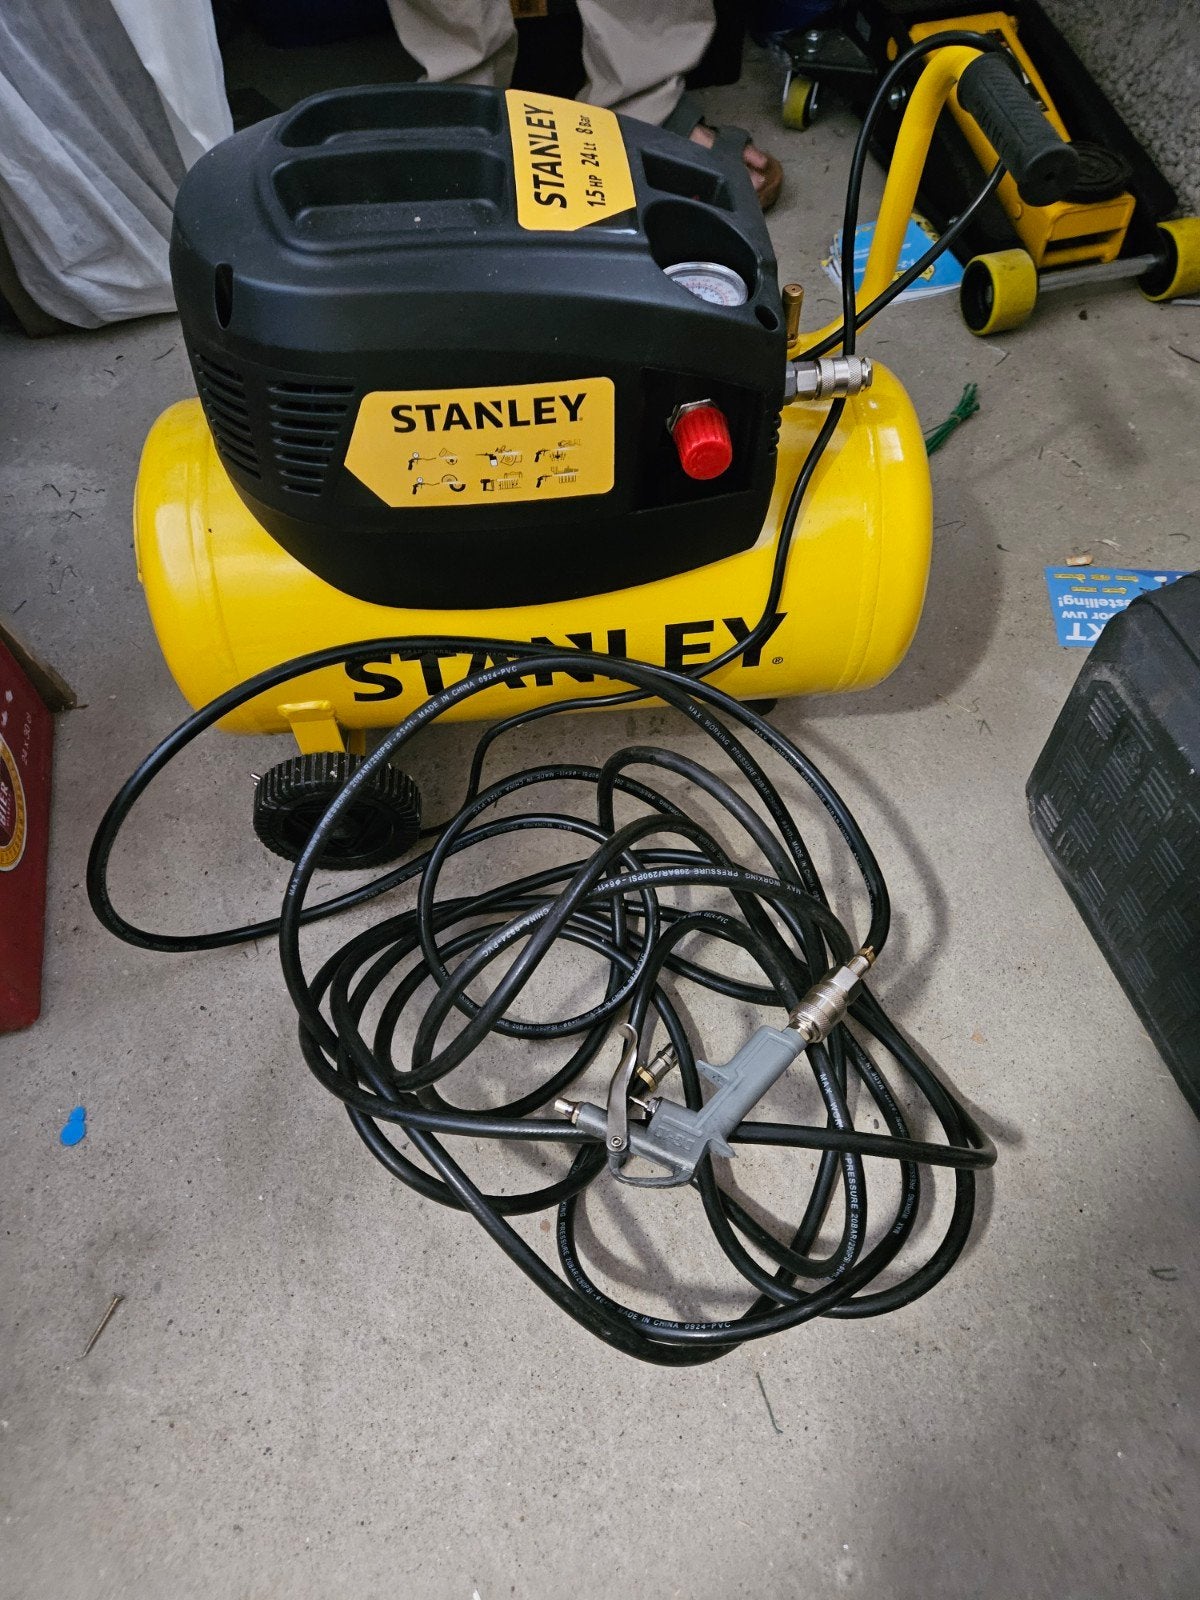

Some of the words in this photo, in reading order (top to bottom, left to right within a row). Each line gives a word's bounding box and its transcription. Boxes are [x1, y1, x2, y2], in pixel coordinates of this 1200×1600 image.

[575, 127, 594, 135] 8
[523, 103, 567, 209] STANLEY
[580, 152, 600, 167] 24
[390, 393, 587, 434] STANLEY
[1061, 610, 1088, 619] uw
[343, 611, 788, 702] STANLEY
[771, 742, 798, 770] WORKING
[287, 878, 300, 897] MAX
[297, 833, 322, 872] WORKING
[319, 788, 352, 830] PRESSURE
[350, 741, 394, 788] 20BAR/290PSI
[416, 700, 440, 720] MADE
[440, 693, 450, 704] IN
[451, 680, 476, 696] CHINA
[478, 665, 519, 684] 0924-PVC
[504, 779, 524, 791] CHINA
[533, 771, 555, 780] MADE
[688, 705, 703, 719] MAX
[704, 719, 731, 746] WORKING
[731, 745, 757, 779] PRESSURE
[791, 840, 804, 859] MADE
[628, 868, 690, 883] 20BAR/290PSI
[693, 867, 740, 878] PRESSURE
[744, 872, 781, 888] WORKING
[786, 883, 802, 896] MAX
[522, 906, 550, 927] CHINA
[819, 1072, 833, 1095] MAX
[844, 1156, 860, 1210] PRESSURE
[892, 1221, 903, 1235] MAX
[901, 1193, 916, 1219] WORKING
[559, 1222, 570, 1257] PRESSURE
[618, 1307, 638, 1321] MADE
[641, 1316, 650, 1325] IN
[653, 1319, 680, 1330] CHINA
[684, 1321, 732, 1331] 0924-PVC
